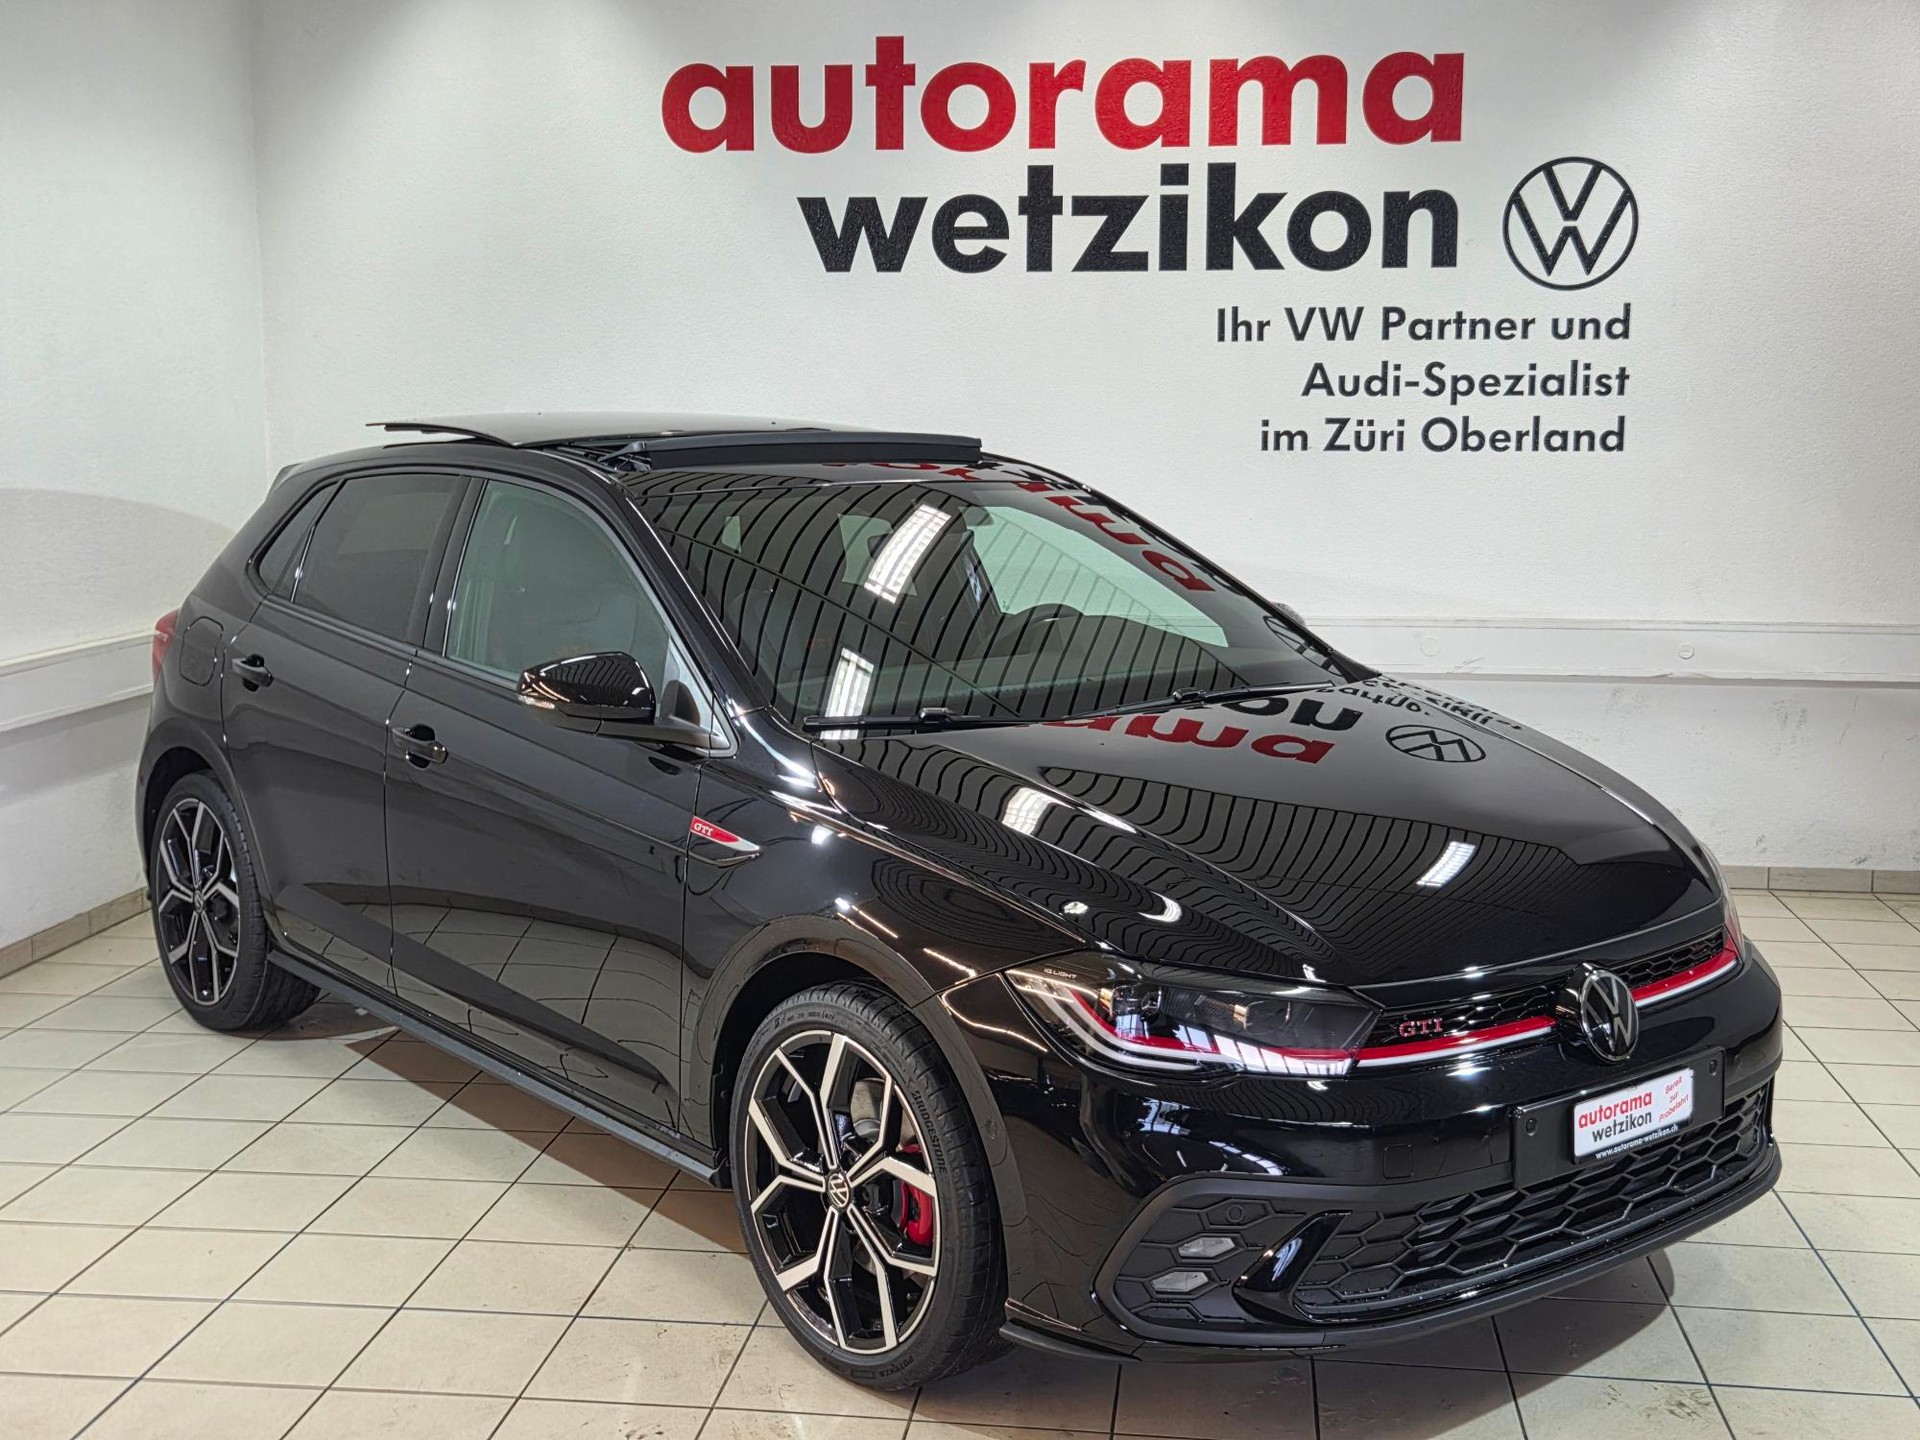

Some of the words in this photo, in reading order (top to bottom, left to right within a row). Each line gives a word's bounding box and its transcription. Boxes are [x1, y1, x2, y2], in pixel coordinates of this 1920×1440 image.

[662, 36, 1464, 153] autorama
[797, 163, 1458, 273] wetzikon
[1503, 157, 1638, 290] VW
[1217, 306, 1271, 342] Ihr
[1284, 307, 1364, 342] VW
[1381, 306, 1536, 341] Partner
[1551, 303, 1631, 340] und
[1301, 360, 1630, 405] Audi-Spezialist
[1261, 419, 1309, 452] im
[1323, 418, 1405, 453] Züri
[1421, 416, 1626, 452] Oberland
[693, 822, 713, 837] GTI
[1399, 1017, 1443, 1038] GTI
[1665, 1076, 1683, 1095] Bereit
[1578, 1091, 1653, 1129] autorama
[1592, 1112, 1653, 1143] wetzikon
[911, 1090, 948, 1175] BRIDGESTONE
